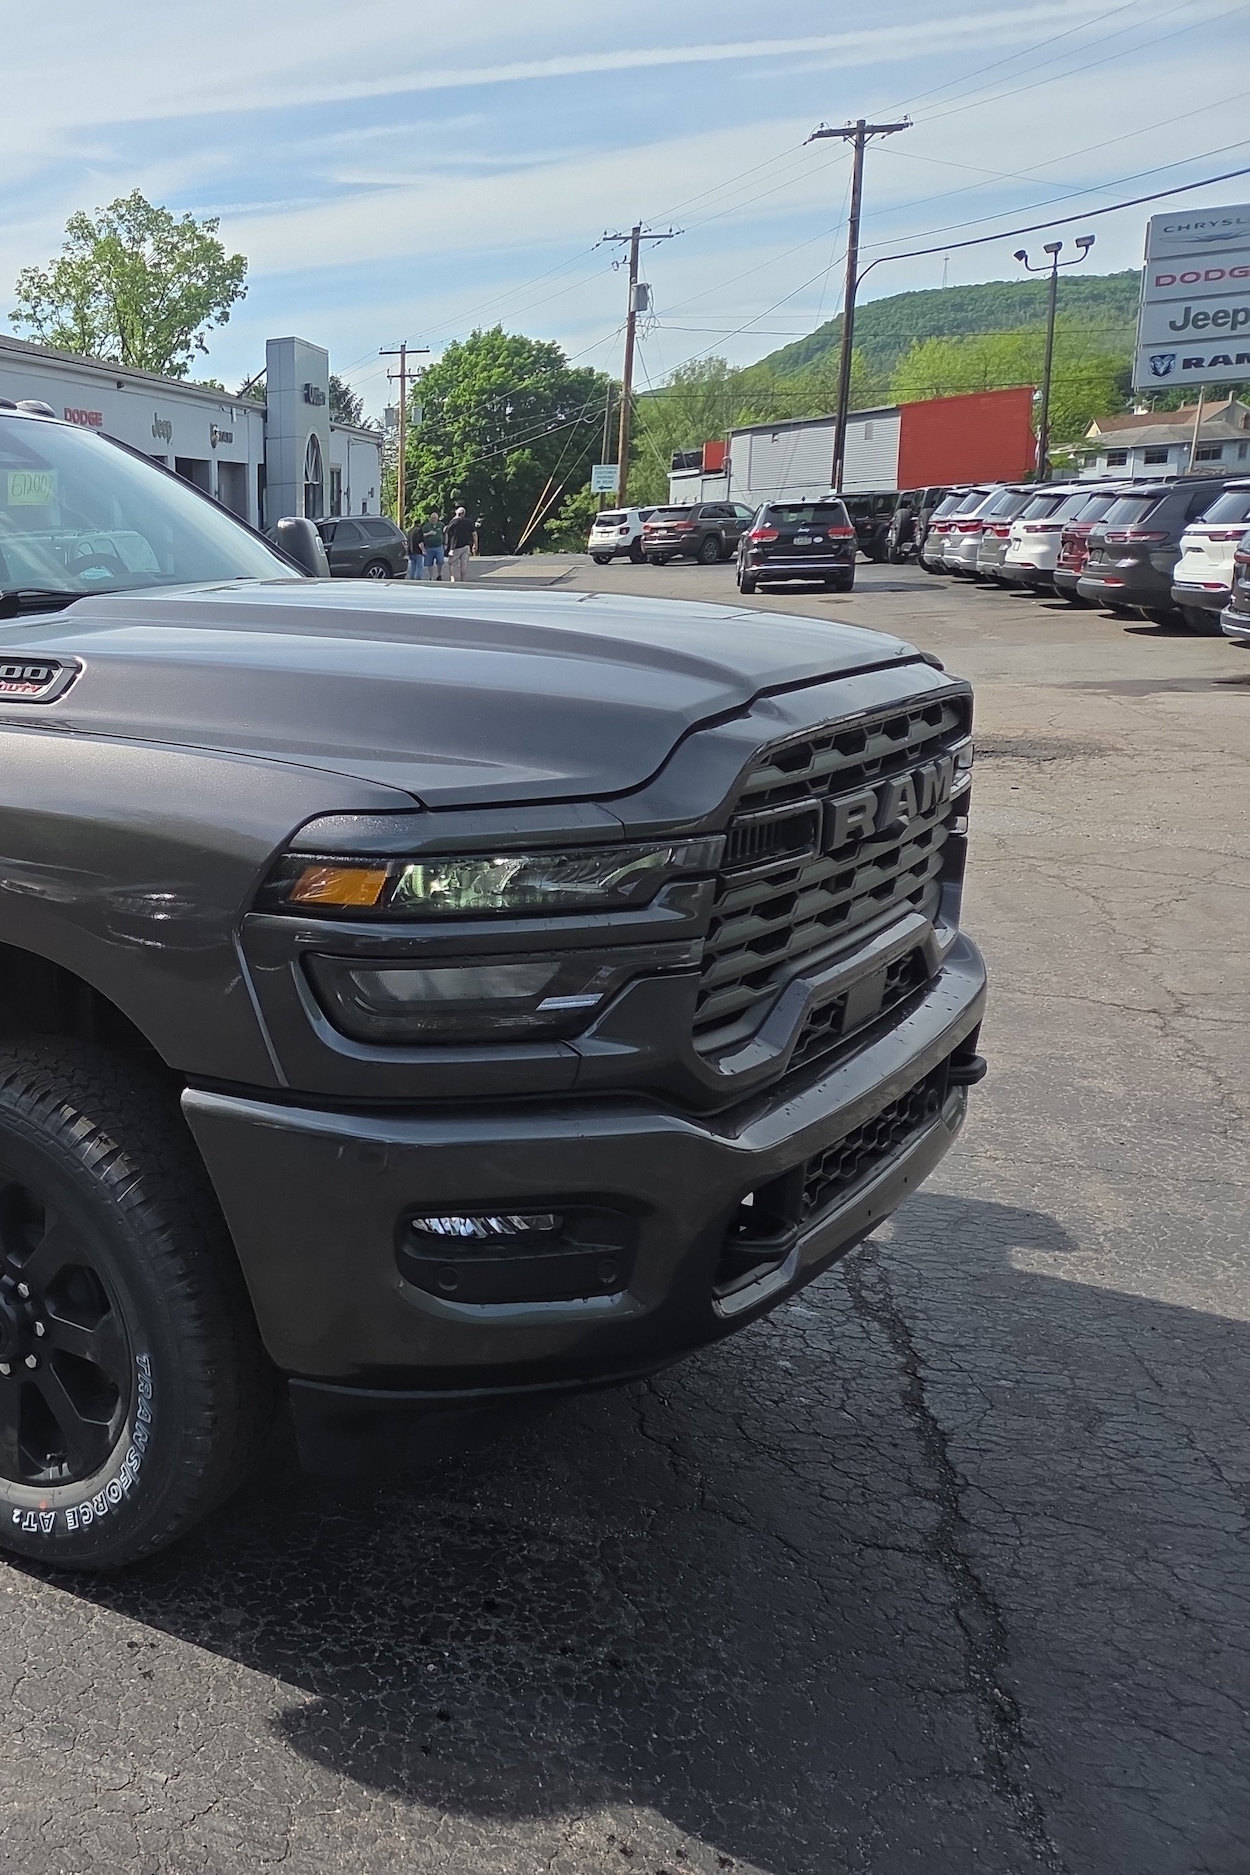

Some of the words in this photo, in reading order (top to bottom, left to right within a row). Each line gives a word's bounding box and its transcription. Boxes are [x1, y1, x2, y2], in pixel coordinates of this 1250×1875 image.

[1163, 217, 1250, 233] CHRYSL
[1169, 306, 1250, 331] Jeep
[64, 408, 103, 427] DODGE
[152, 412, 172, 445] Jeep
[825, 755, 953, 852] RAM
[65, 1353, 153, 1530] TRANSFORCE
